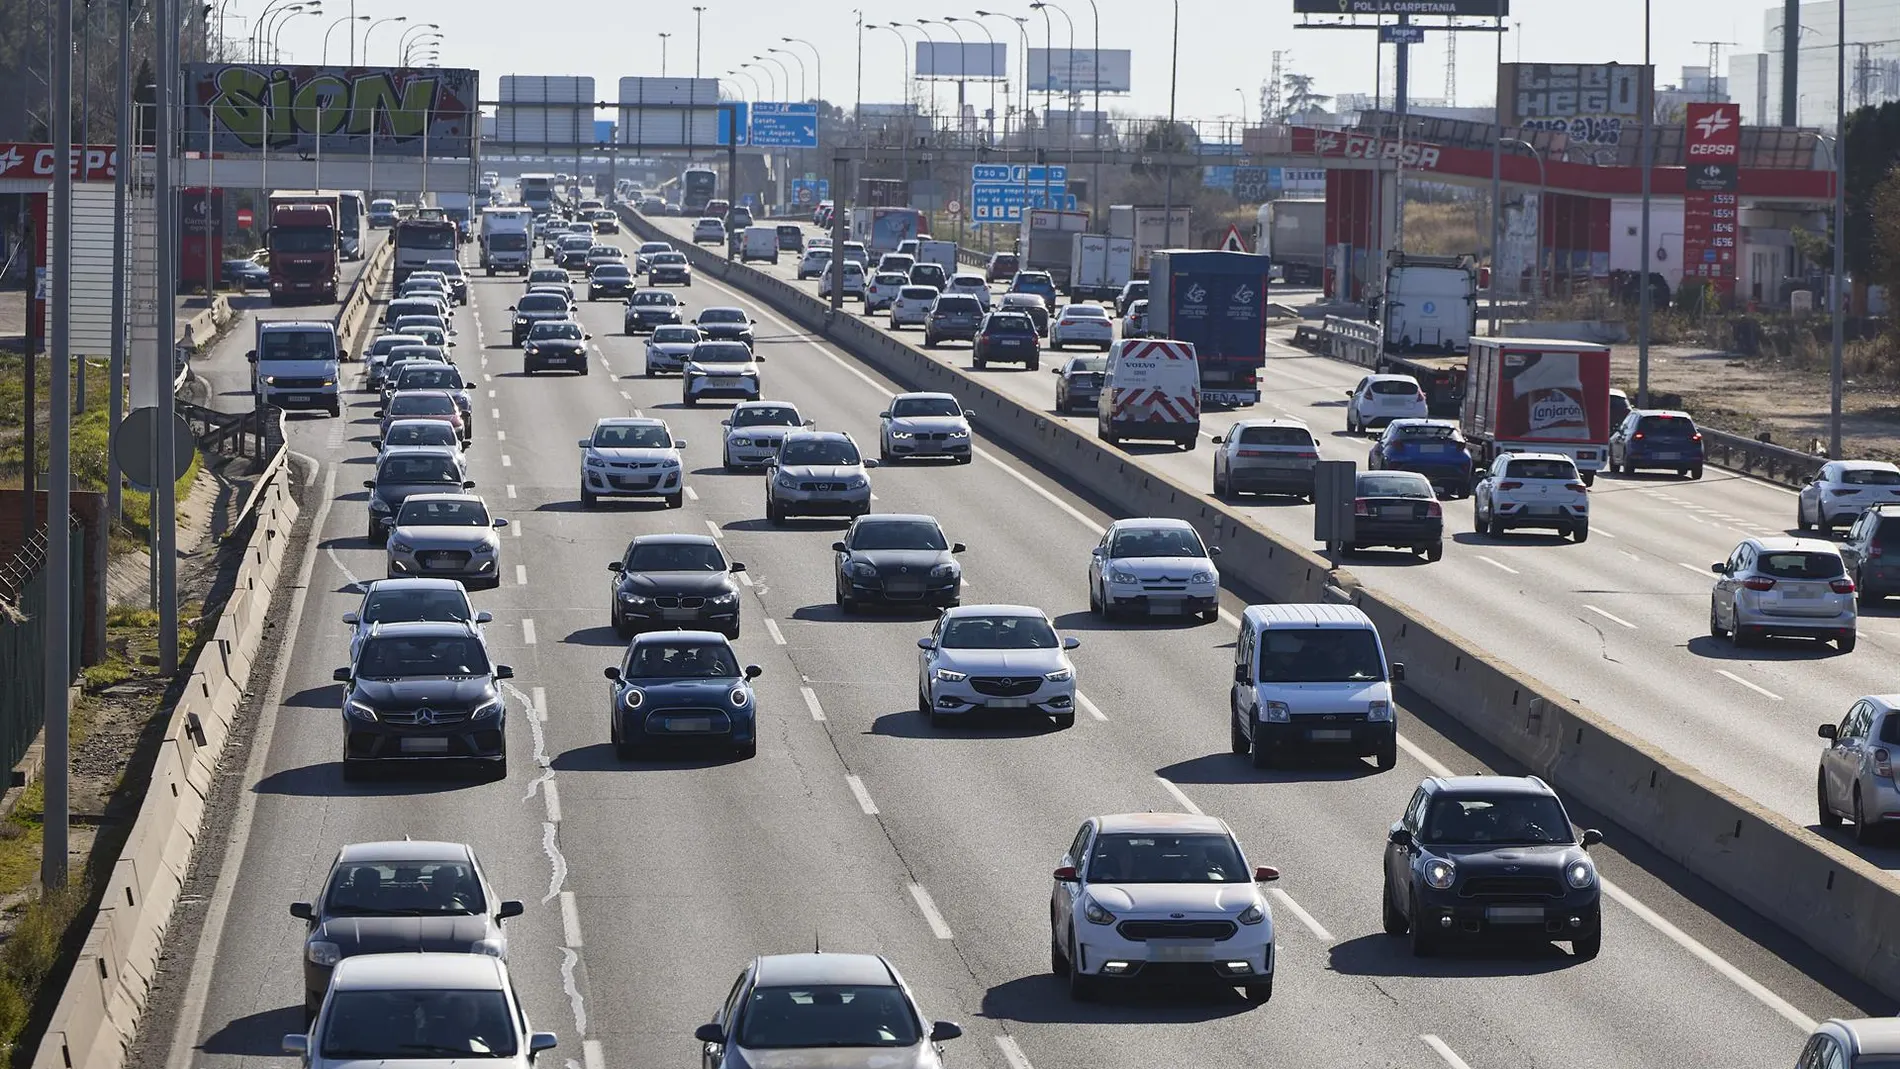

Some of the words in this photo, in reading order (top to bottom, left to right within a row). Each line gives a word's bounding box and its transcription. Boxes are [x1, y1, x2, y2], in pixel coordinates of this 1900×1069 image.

[1354, 2, 1376, 11] POL.
[1380, 2, 1392, 11] LA
[1393, 2, 1456, 12] CARPETANIA
[1690, 143, 1735, 155] CEPSA
[1533, 404, 1582, 421] Lanjarón
